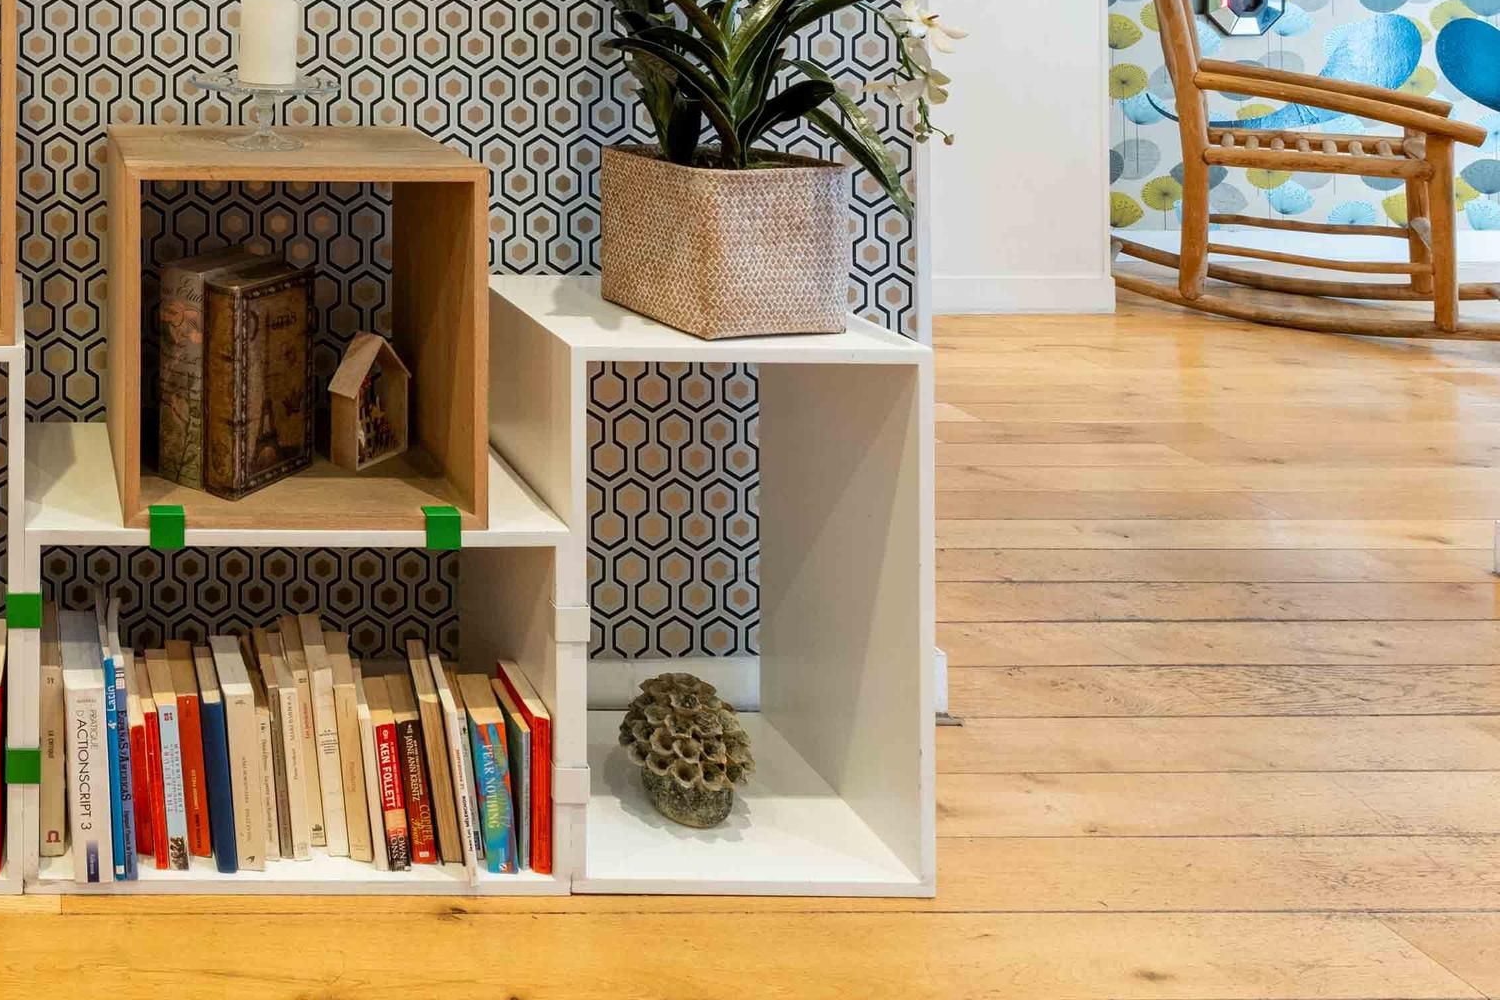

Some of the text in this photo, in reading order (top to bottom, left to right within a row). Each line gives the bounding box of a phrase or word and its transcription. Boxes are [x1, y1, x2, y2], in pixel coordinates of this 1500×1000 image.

[89, 709, 98, 749] PRATIQUE
[107, 685, 117, 712] Latin
[76, 710, 92, 830] D'ACTIONSCRIPT 3
[379, 743, 396, 808] KEN FOLLETT
[404, 735, 420, 802] JAYNE ANN KRENTZ
[482, 744, 501, 829] FEAR NOTHING
[419, 804, 433, 842] COPPER
